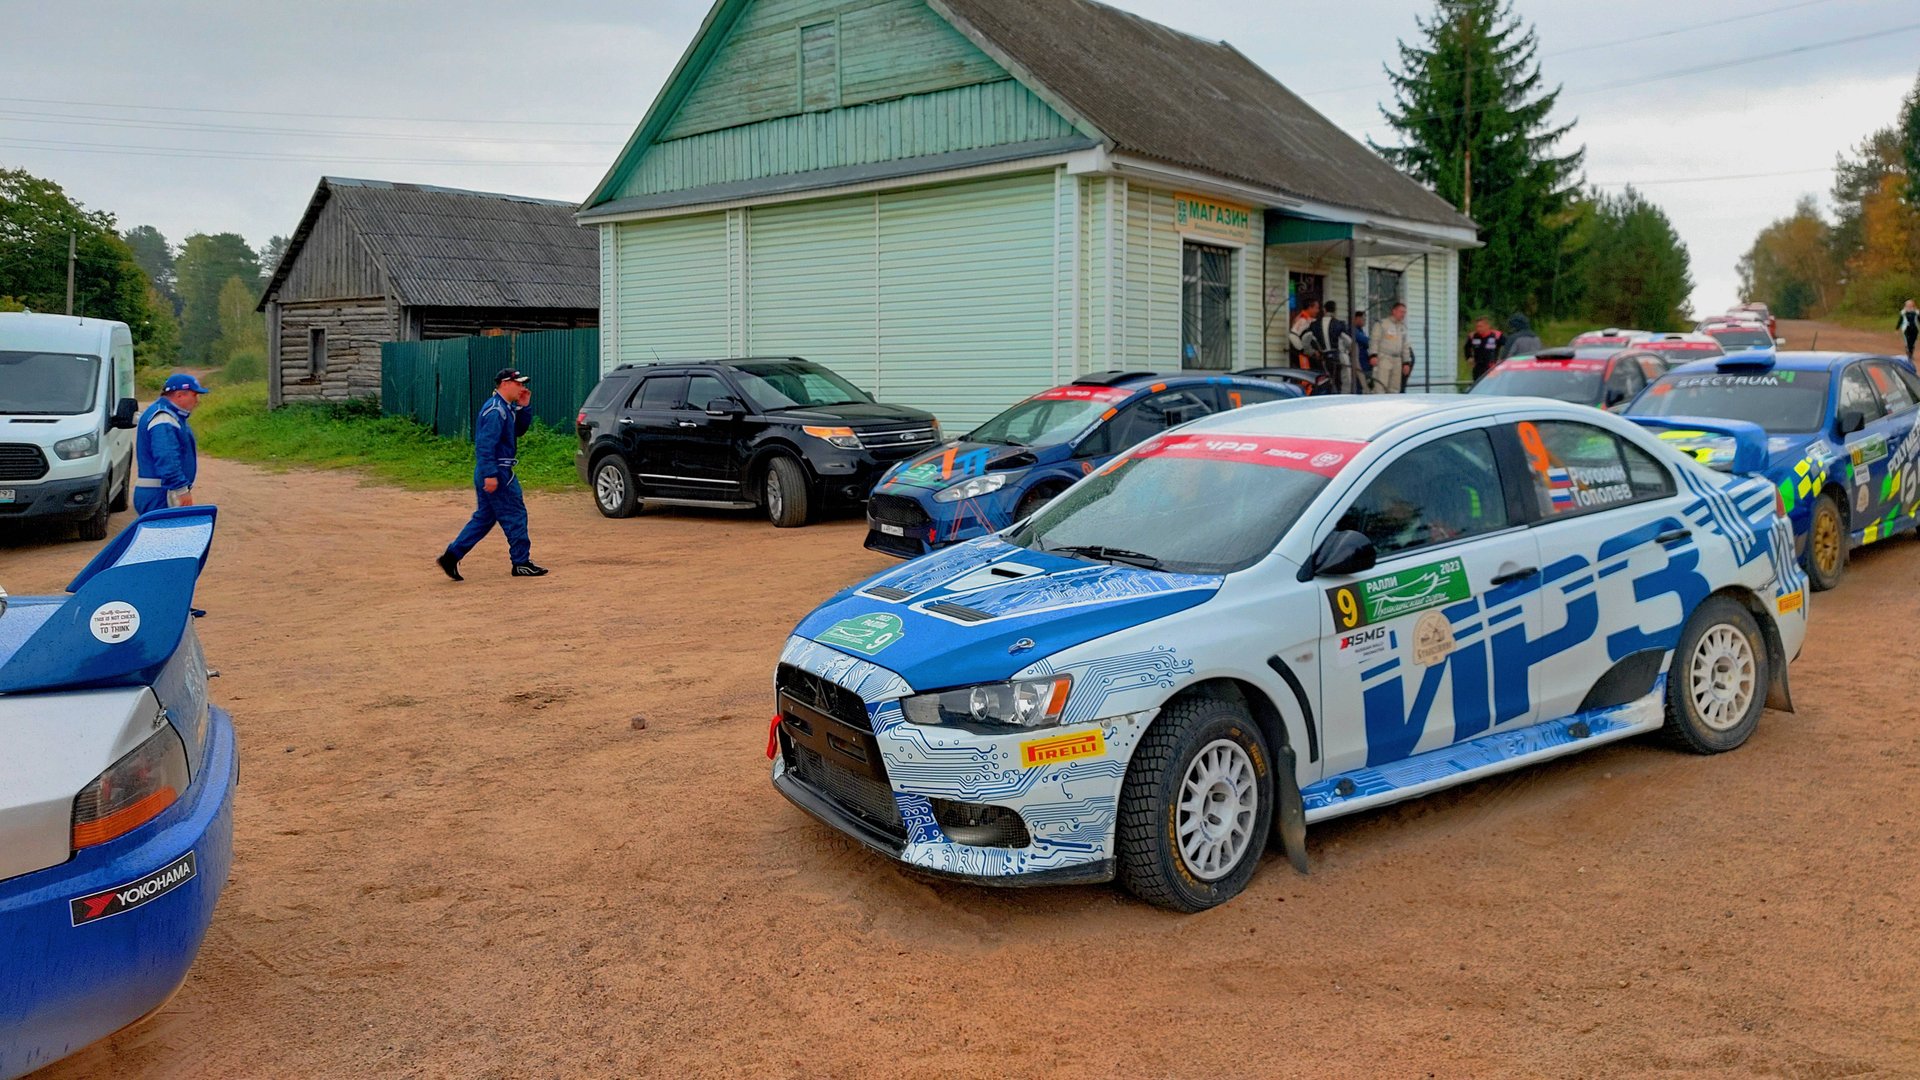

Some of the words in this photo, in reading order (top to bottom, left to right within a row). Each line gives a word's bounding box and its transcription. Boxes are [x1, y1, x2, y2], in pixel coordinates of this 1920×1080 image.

[1190, 201, 1248, 228] МАГАЗИН
[1677, 376, 1778, 387] SPECTRUM
[1206, 440, 1258, 452] ЧРР
[1517, 421, 1549, 471] 9
[1568, 464, 1626, 486] Рогозин
[1570, 483, 1633, 508] Тополев
[1440, 560, 1460, 575] 2023
[1366, 576, 1398, 593] РАЛЛИ
[1337, 588, 1358, 628] 9
[100, 626, 109, 634] TO
[111, 625, 130, 633] THINK
[866, 633, 893, 649] 9
[1341, 626, 1385, 650] RSMG
[1361, 516, 1713, 768] ИРЗ
[1027, 735, 1097, 763] PIRELLI
[116, 862, 190, 906] YOKOHAMA
